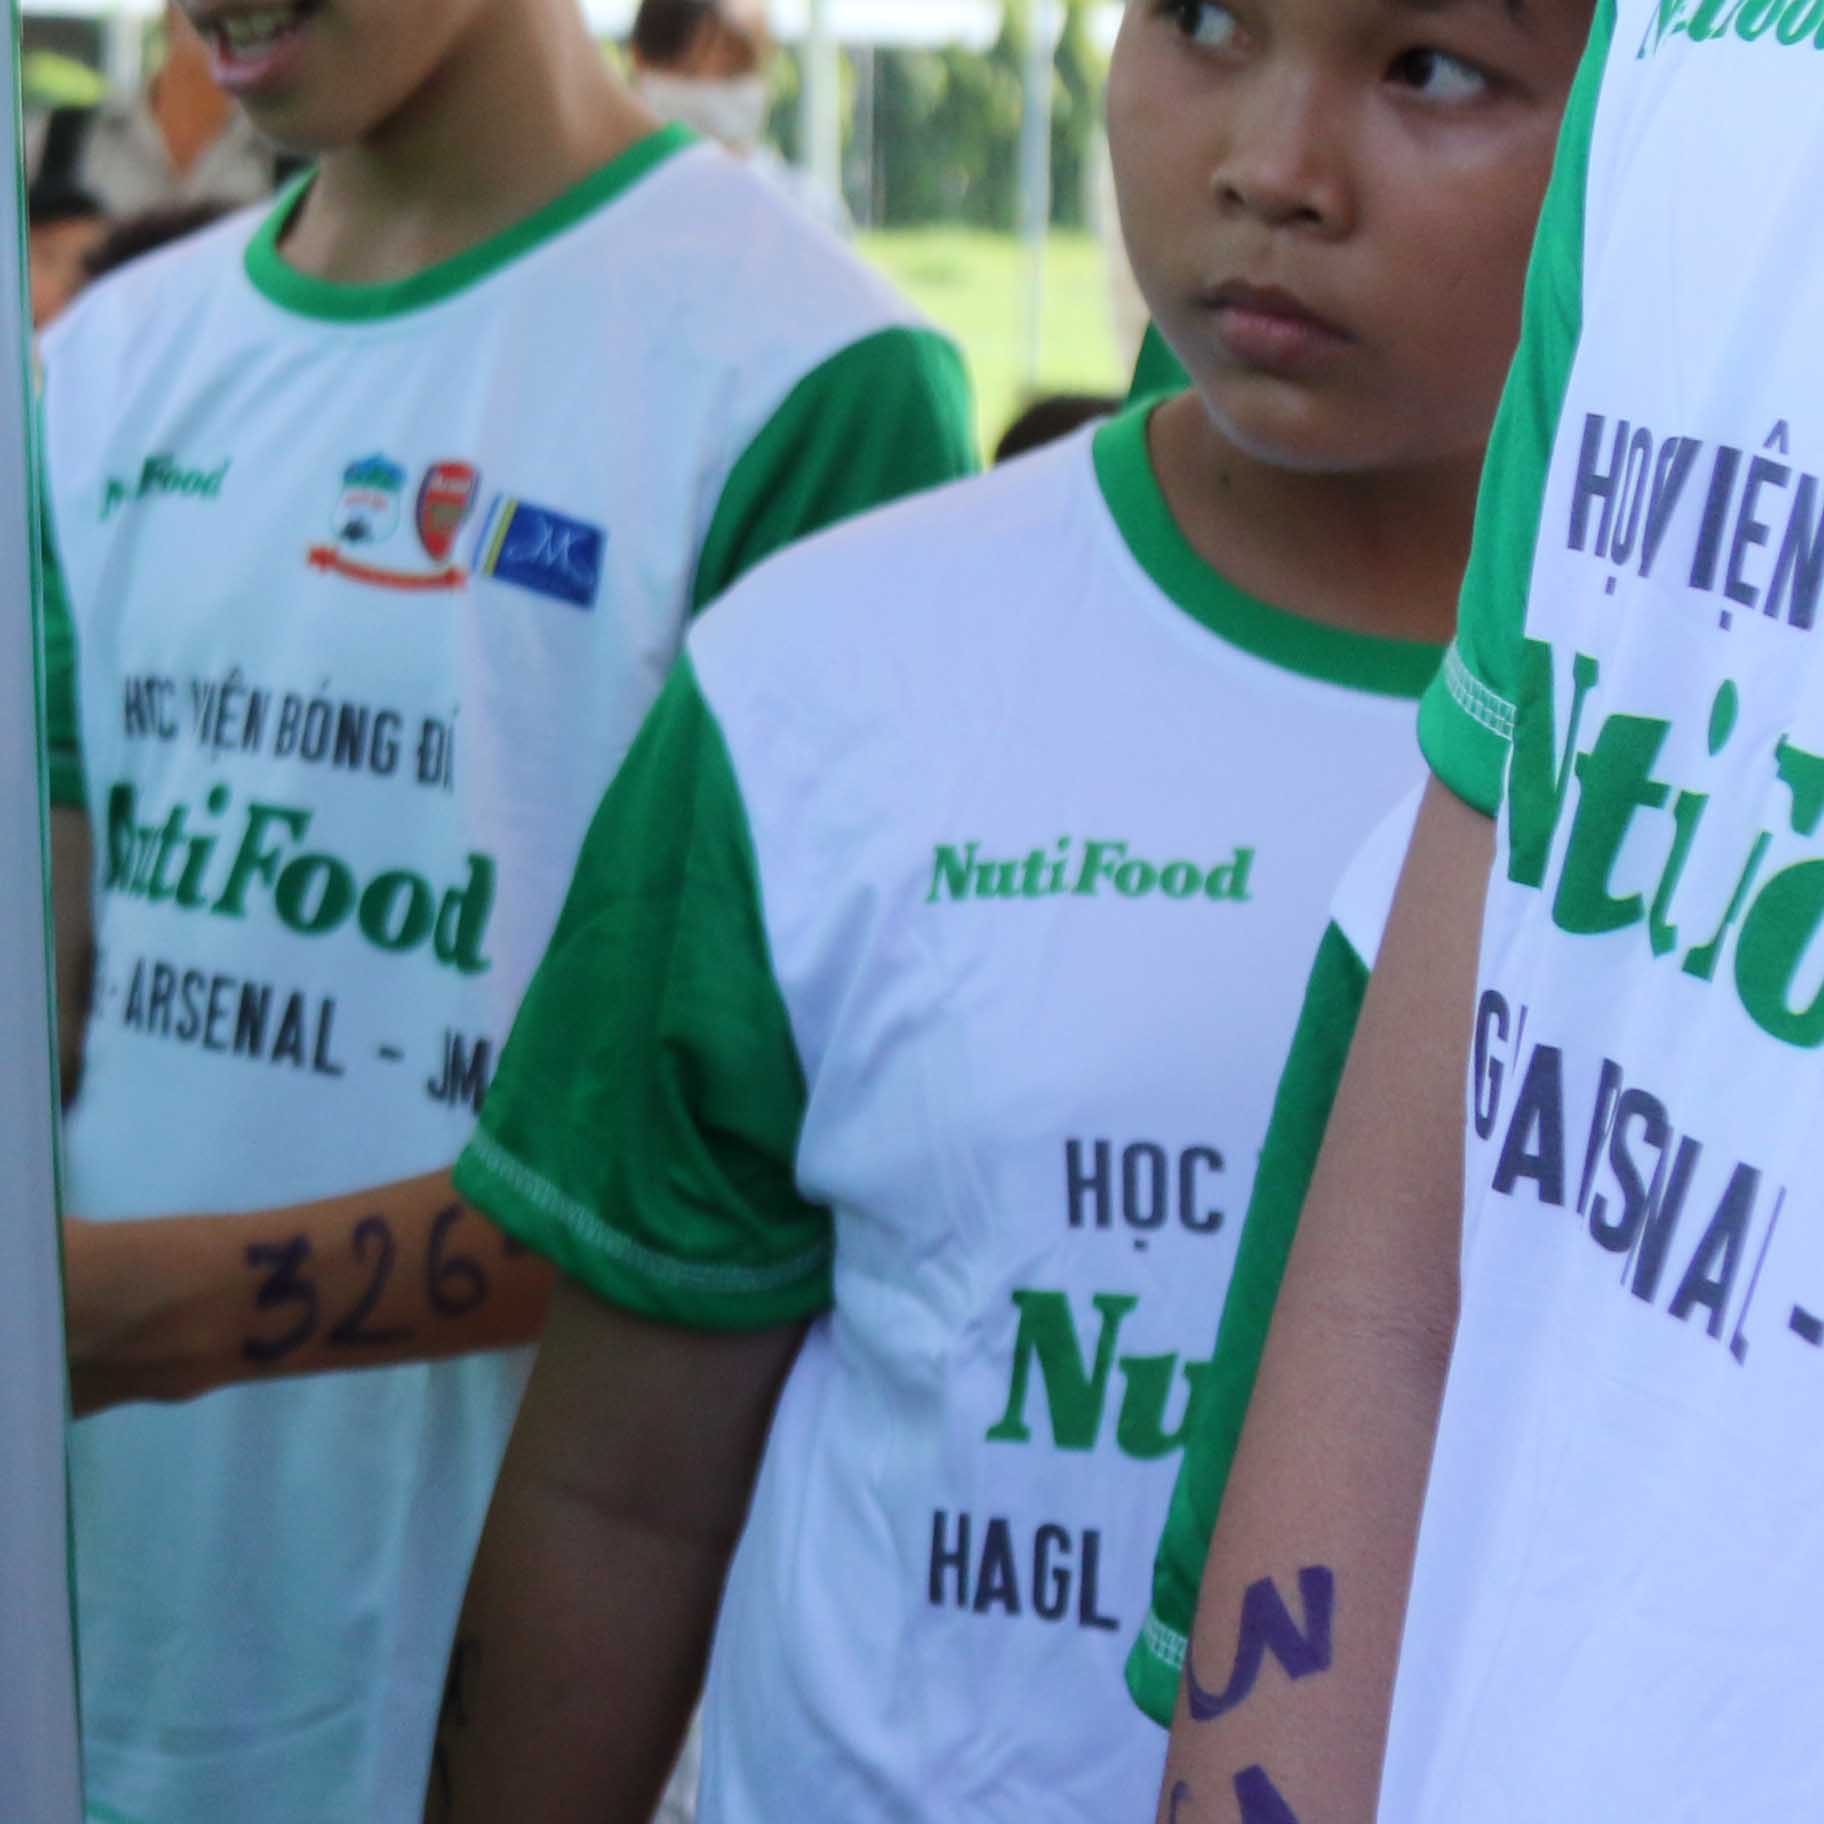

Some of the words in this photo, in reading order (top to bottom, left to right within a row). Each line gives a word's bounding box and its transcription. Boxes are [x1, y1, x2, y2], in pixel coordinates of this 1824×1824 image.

[274, 677, 402, 776] BÓNG
[925, 834, 1255, 905] NutiFood
[123, 956, 346, 1080] ARSENAL
[426, 1023, 494, 1118] JM
[1065, 1138, 1226, 1253] HỌC
[244, 1204, 530, 1365] 326
[929, 1509, 1121, 1633] HAGL
